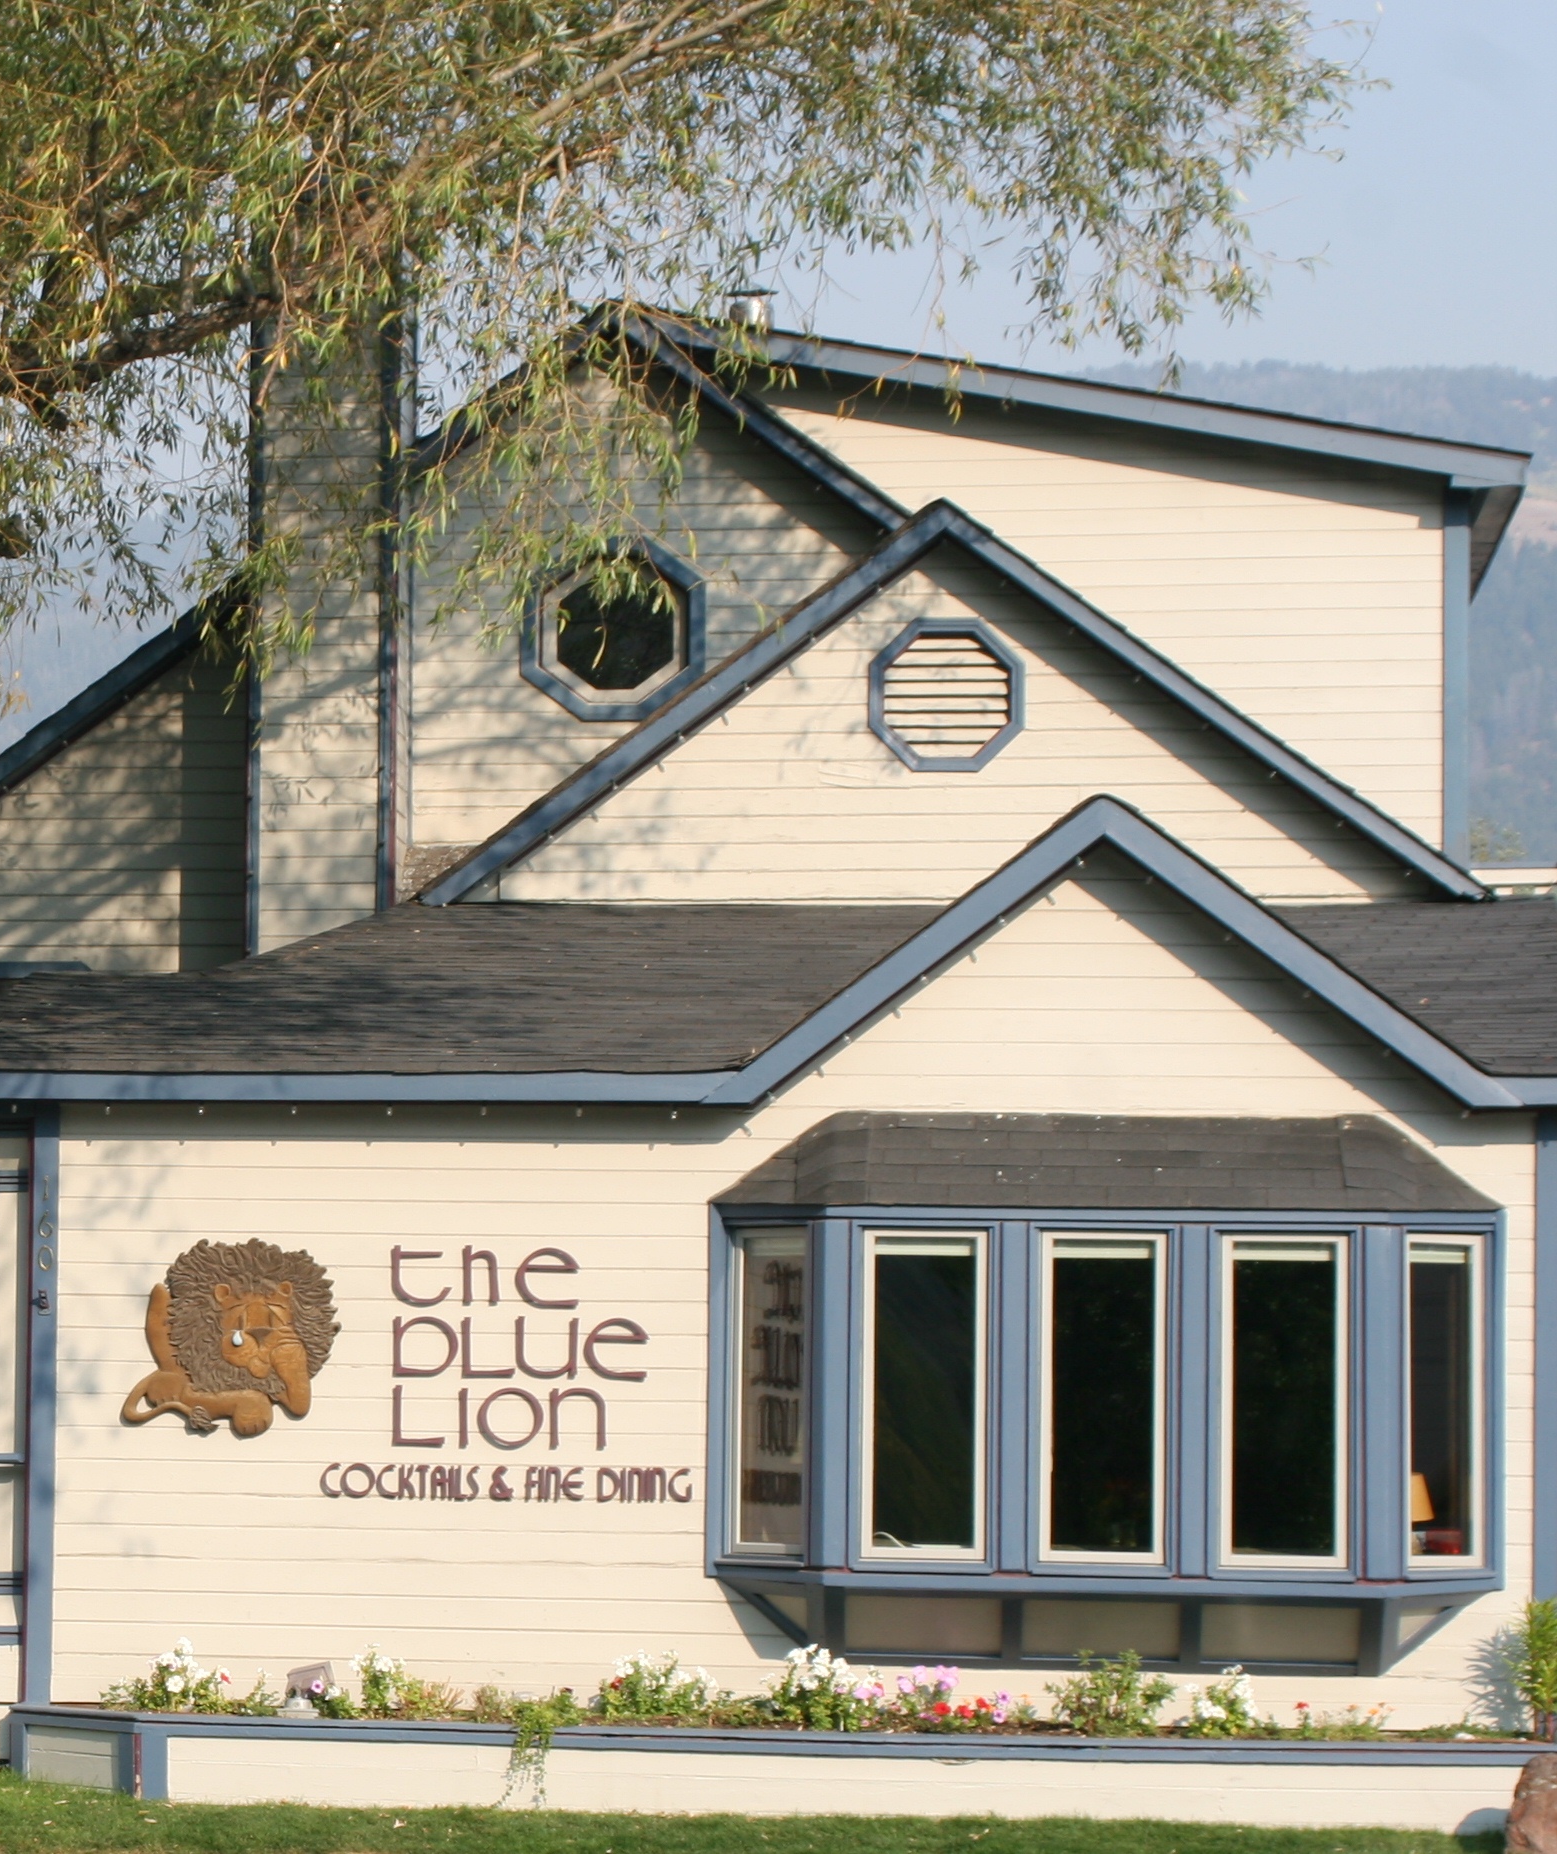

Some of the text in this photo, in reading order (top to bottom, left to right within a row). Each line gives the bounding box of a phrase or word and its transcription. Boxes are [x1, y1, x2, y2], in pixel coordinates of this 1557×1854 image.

[319, 1462, 693, 1503] COCKTAILS & FINE DINING
